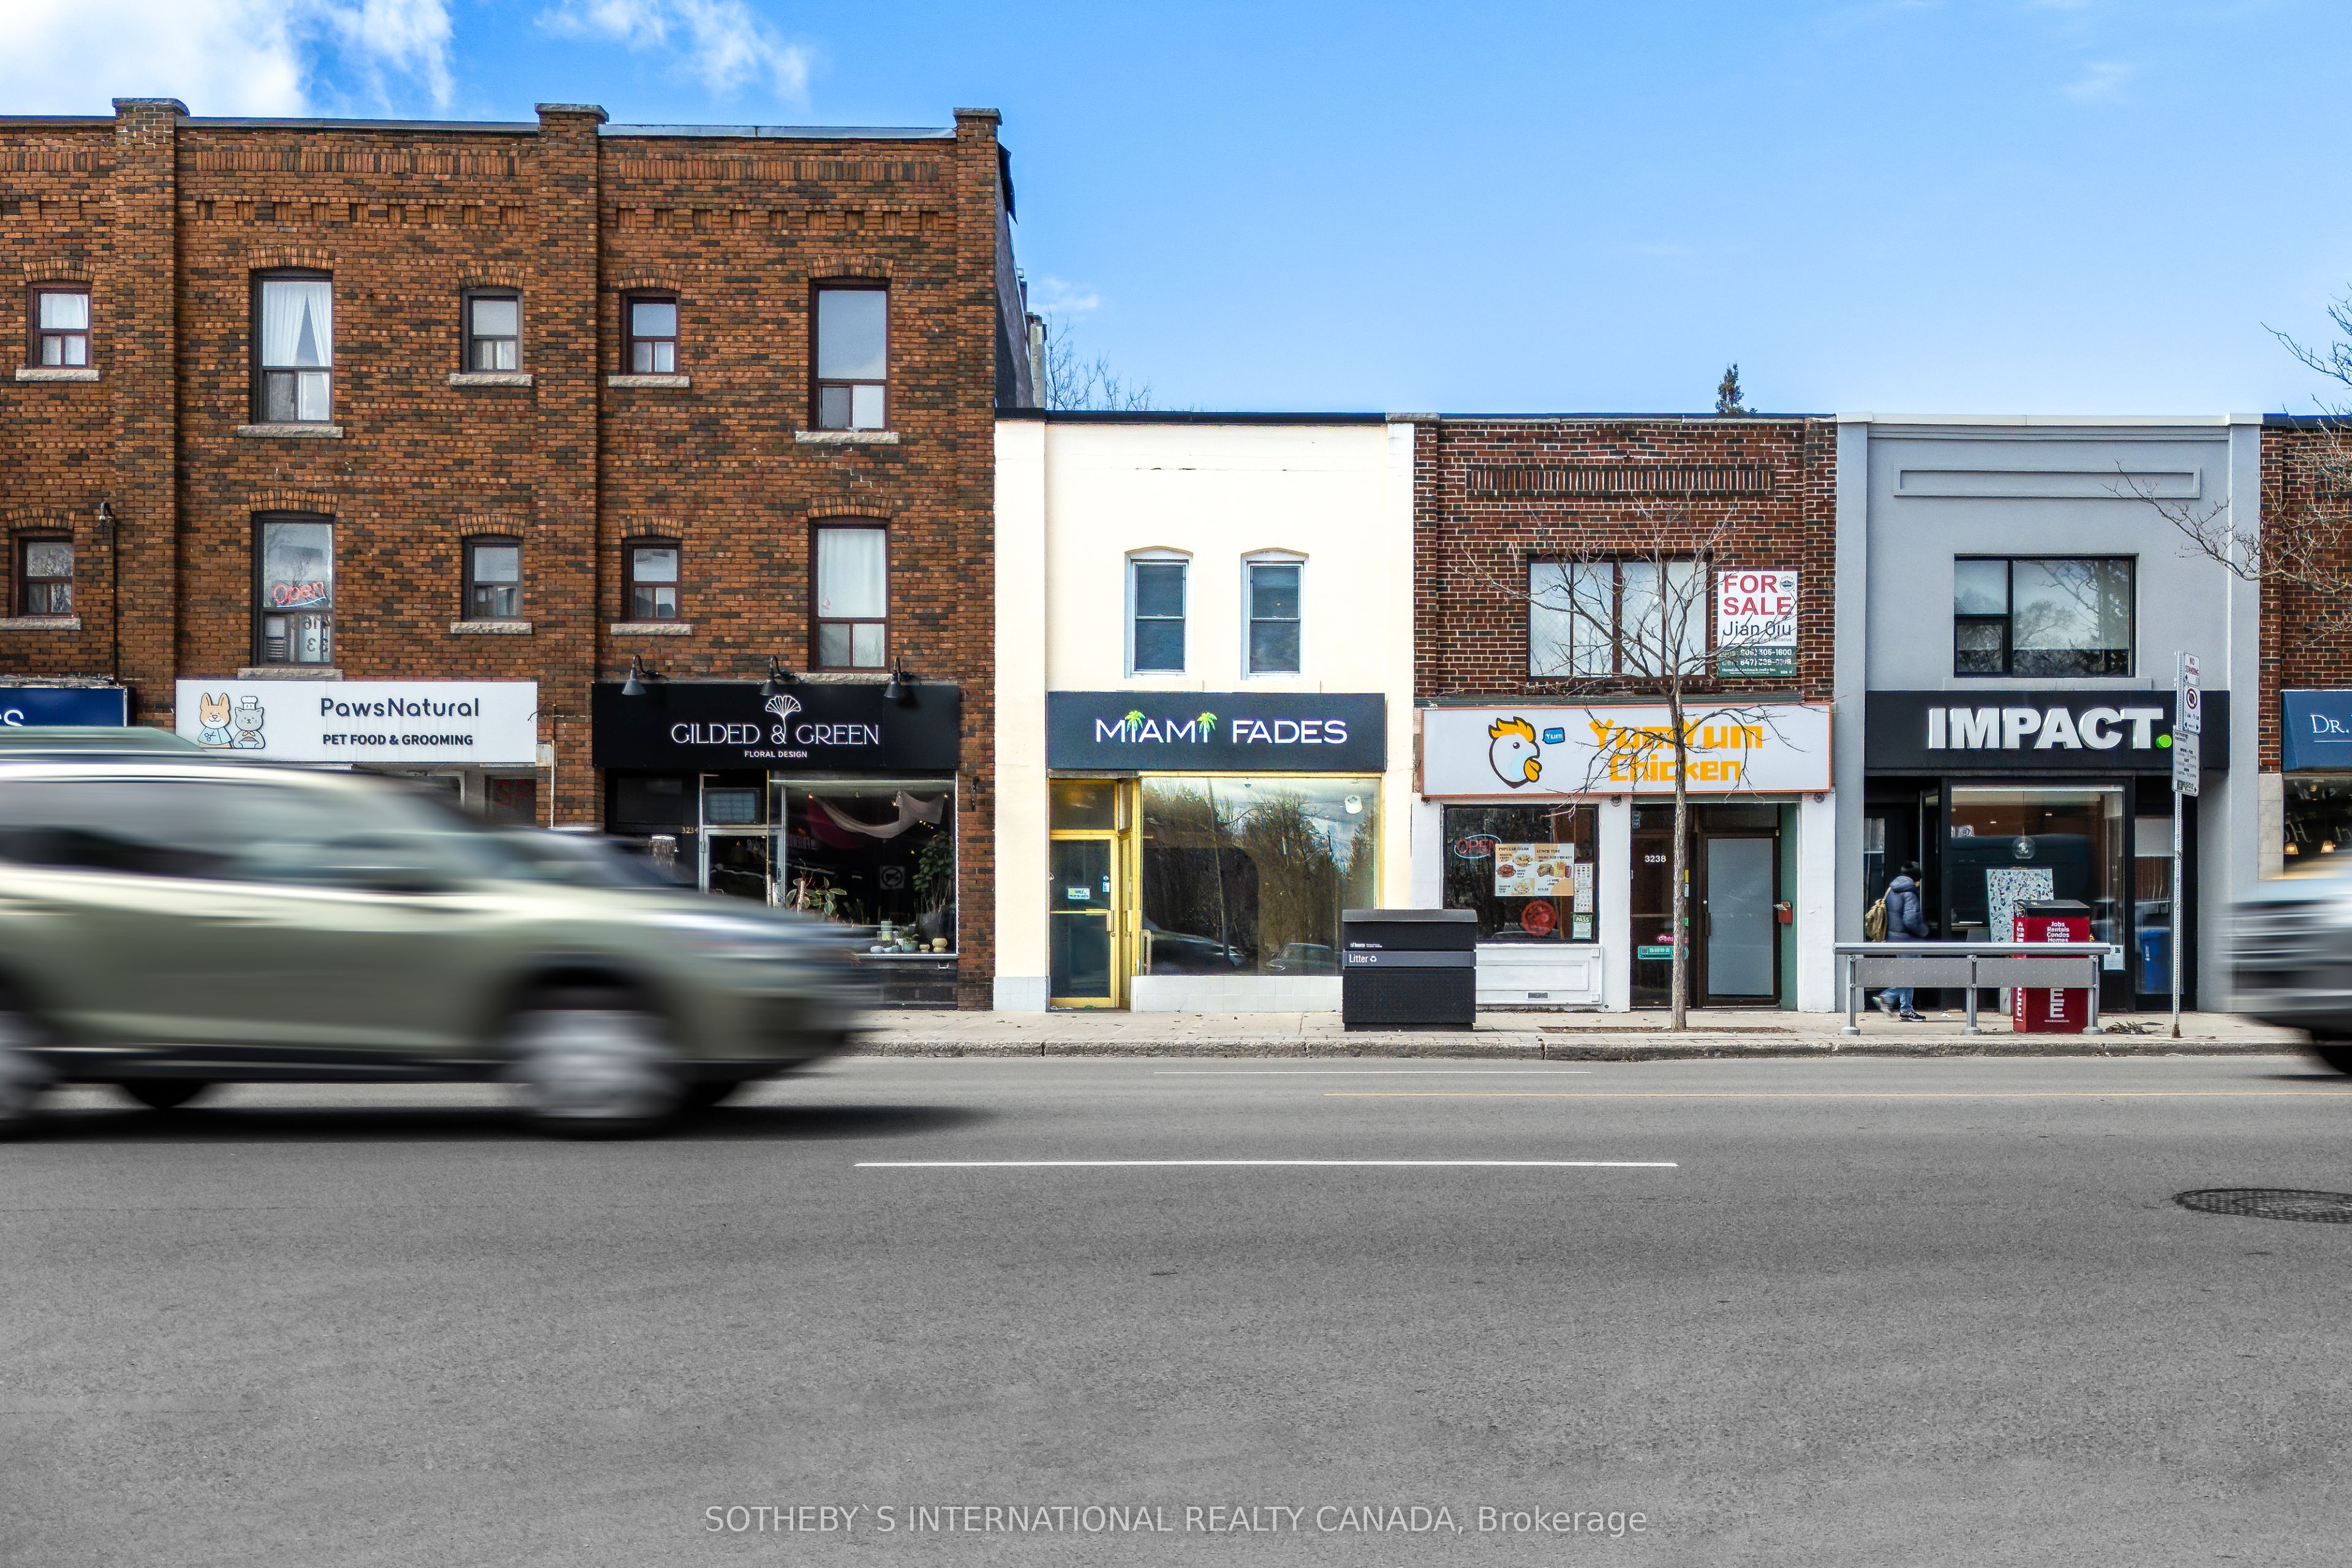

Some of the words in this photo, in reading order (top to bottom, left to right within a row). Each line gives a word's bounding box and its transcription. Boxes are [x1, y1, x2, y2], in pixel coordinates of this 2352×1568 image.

[273, 581, 325, 605] Open
[1724, 575, 1778, 594] FOR
[1723, 597, 1792, 616] SALE
[1723, 621, 1760, 637] Jian
[321, 698, 479, 717] PawsNatural
[671, 723, 761, 745] GILDED
[771, 724, 788, 745] &
[796, 723, 880, 745] GREEN
[1095, 710, 1218, 744] MIAMI
[1232, 720, 1348, 744] FADES
[323, 734, 348, 745] PET
[350, 734, 386, 745] FOOD
[389, 734, 400, 745] &
[401, 734, 474, 745] GROOMING
[1609, 754, 1741, 782] Chicken
[1457, 839, 1498, 854] OPEN
[1349, 954, 1369, 963] Litter
